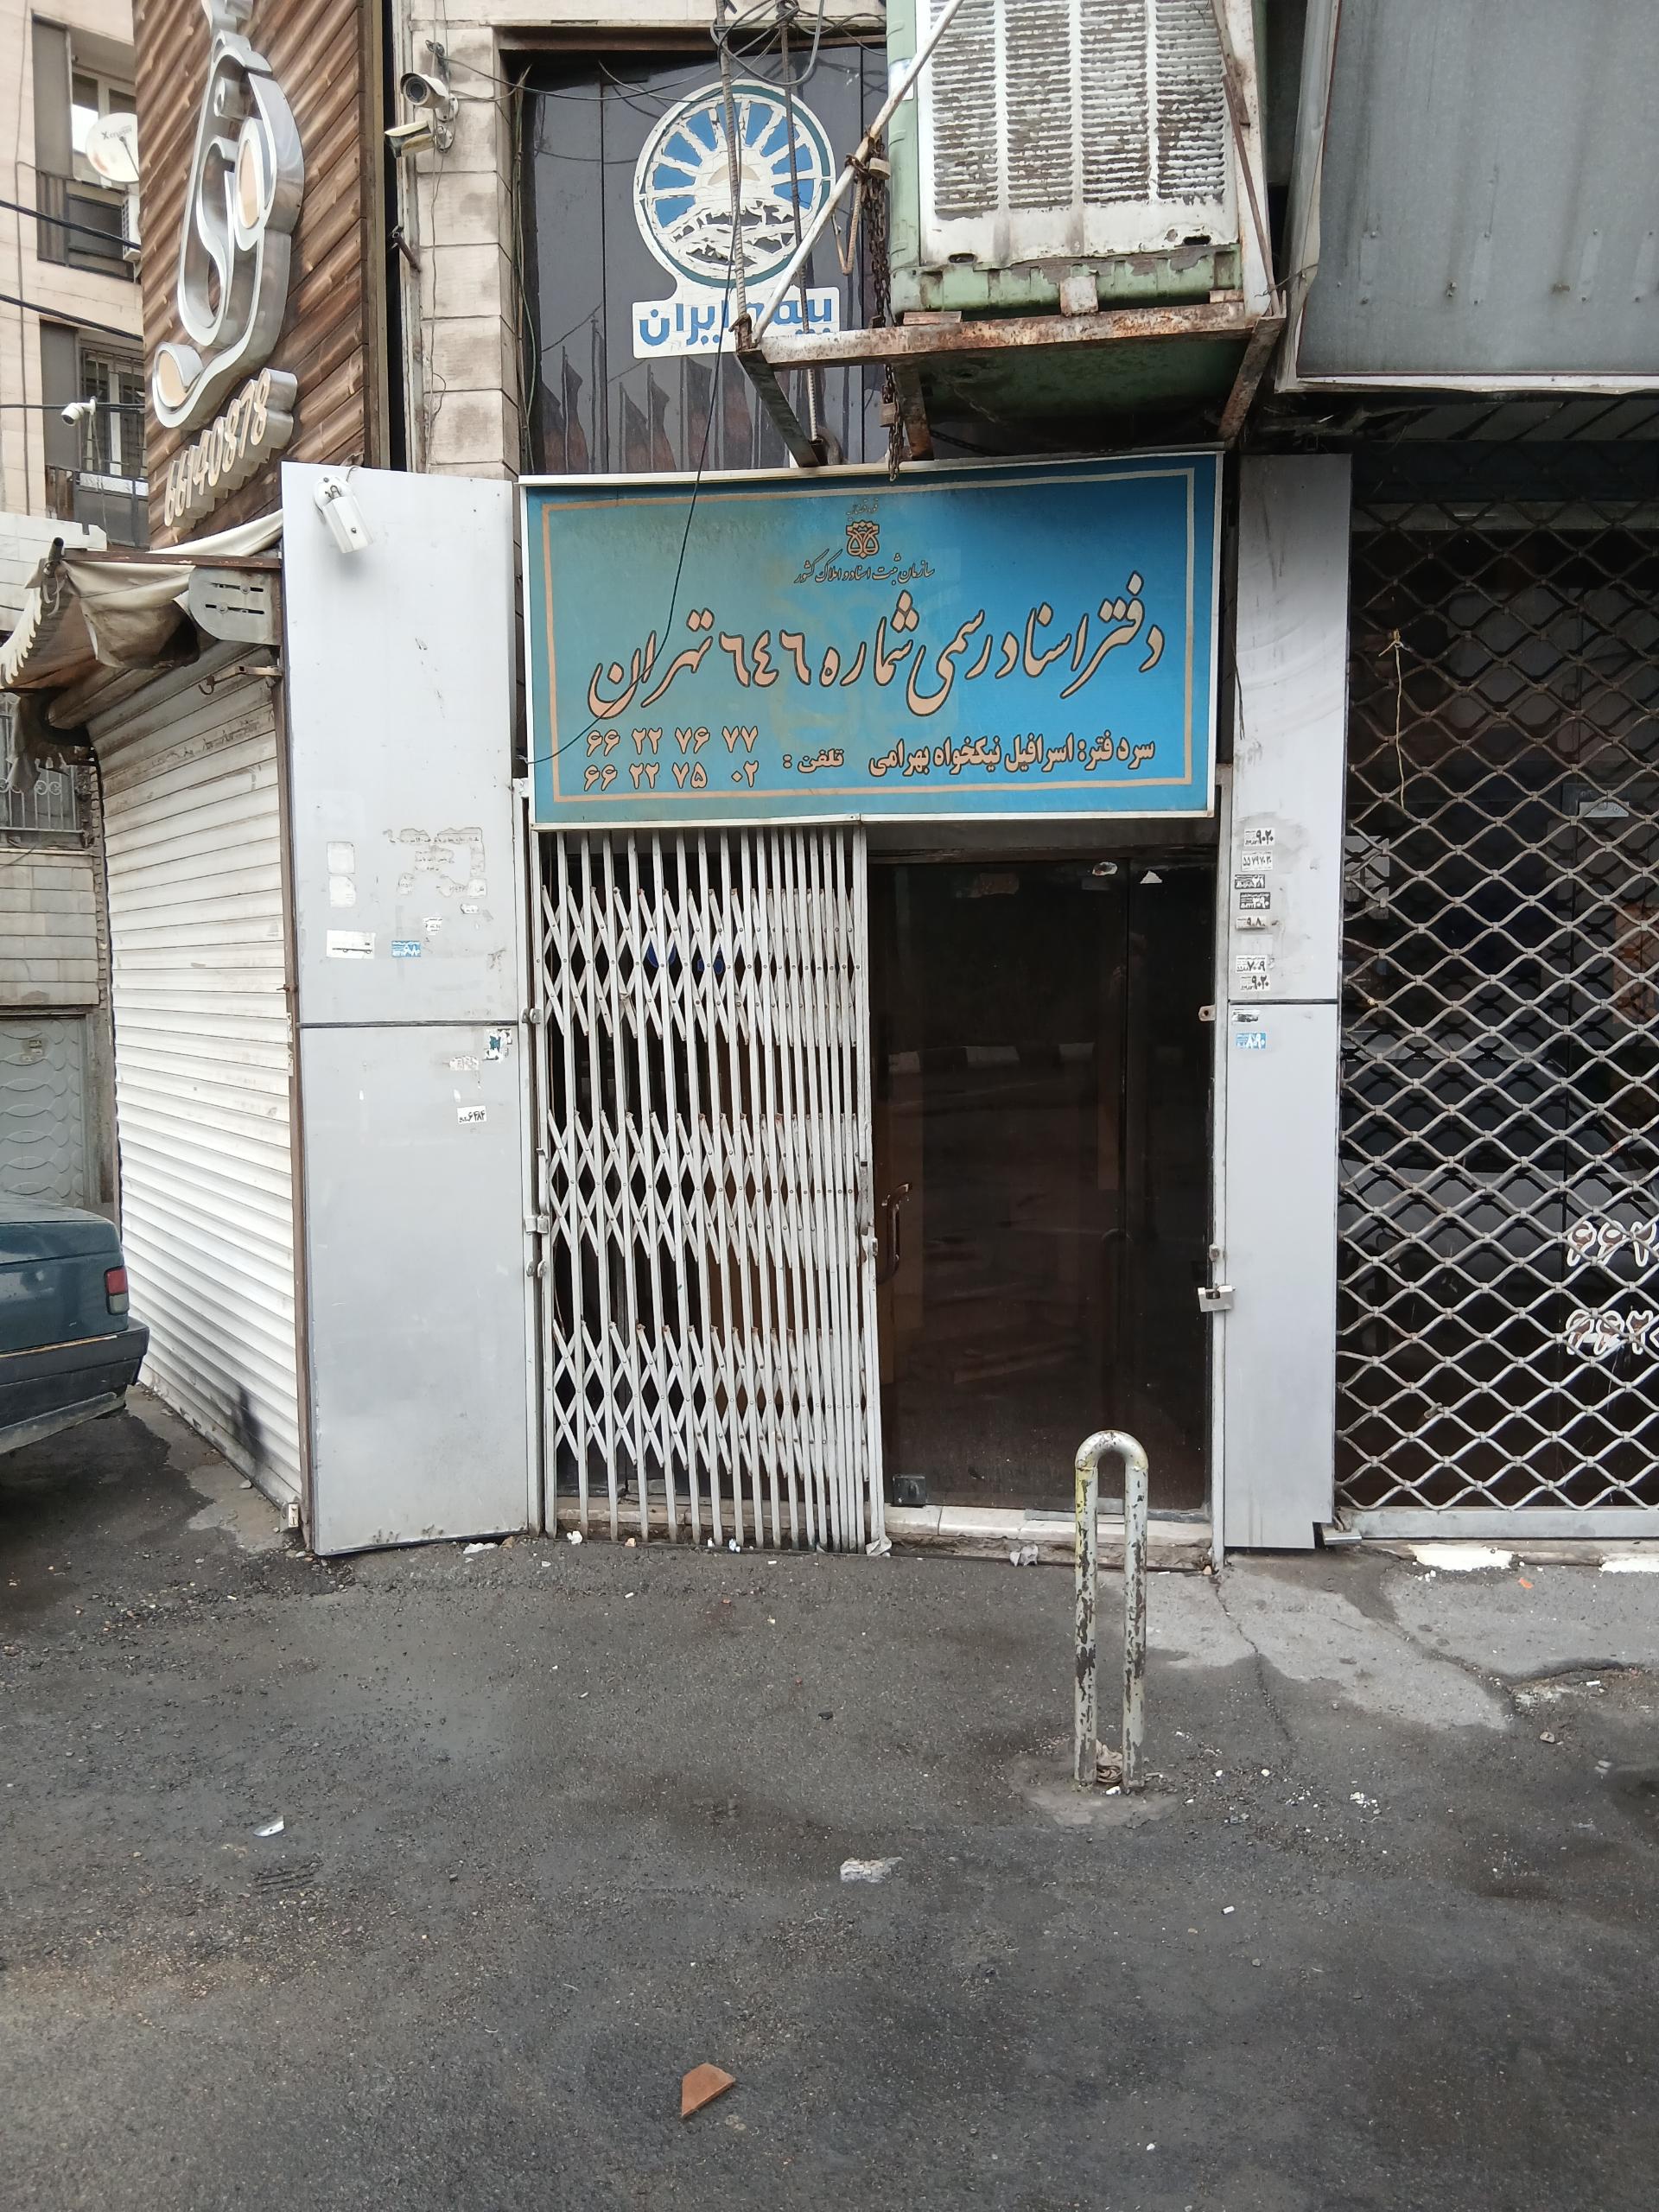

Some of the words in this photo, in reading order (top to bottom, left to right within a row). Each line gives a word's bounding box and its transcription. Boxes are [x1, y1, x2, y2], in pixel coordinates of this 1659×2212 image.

[639, 300, 730, 346] ایران
[164, 368, 271, 527] 66140878
[793, 548, 830, 584] کشور
[815, 549, 843, 583] املاک
[849, 564, 872, 582] اسناد
[872, 552, 902, 586] ثبت
[898, 560, 936, 584] سازمان
[820, 589, 919, 688] شماره
[995, 601, 1089, 679] اسناد
[1060, 570, 1165, 700] دفتر
[587, 607, 715, 720] تهران
[906, 608, 994, 717] رسمی
[868, 738, 930, 778] بهرامی
[932, 734, 1002, 775] نیکخواه
[1004, 732, 1074, 772] اسرافیل
